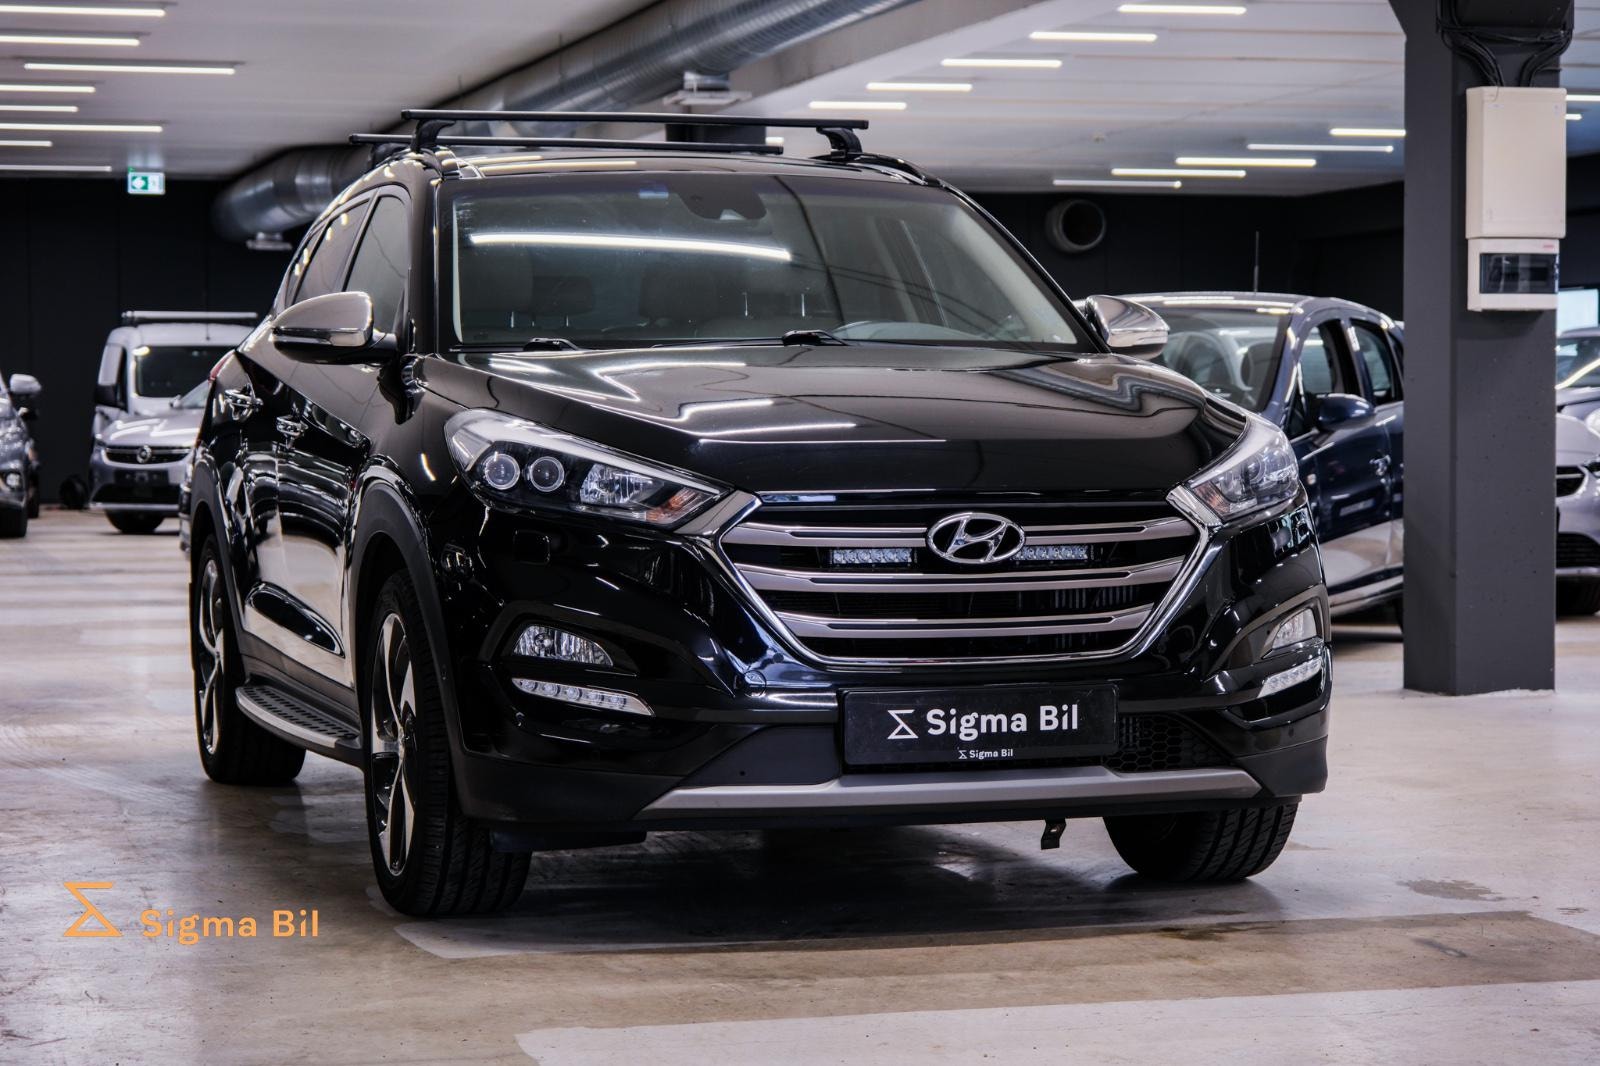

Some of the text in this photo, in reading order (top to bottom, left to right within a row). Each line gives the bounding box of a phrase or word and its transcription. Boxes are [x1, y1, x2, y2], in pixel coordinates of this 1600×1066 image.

[926, 704, 1078, 741] Sigma Bil
[969, 748, 1014, 760] Sigma Bil
